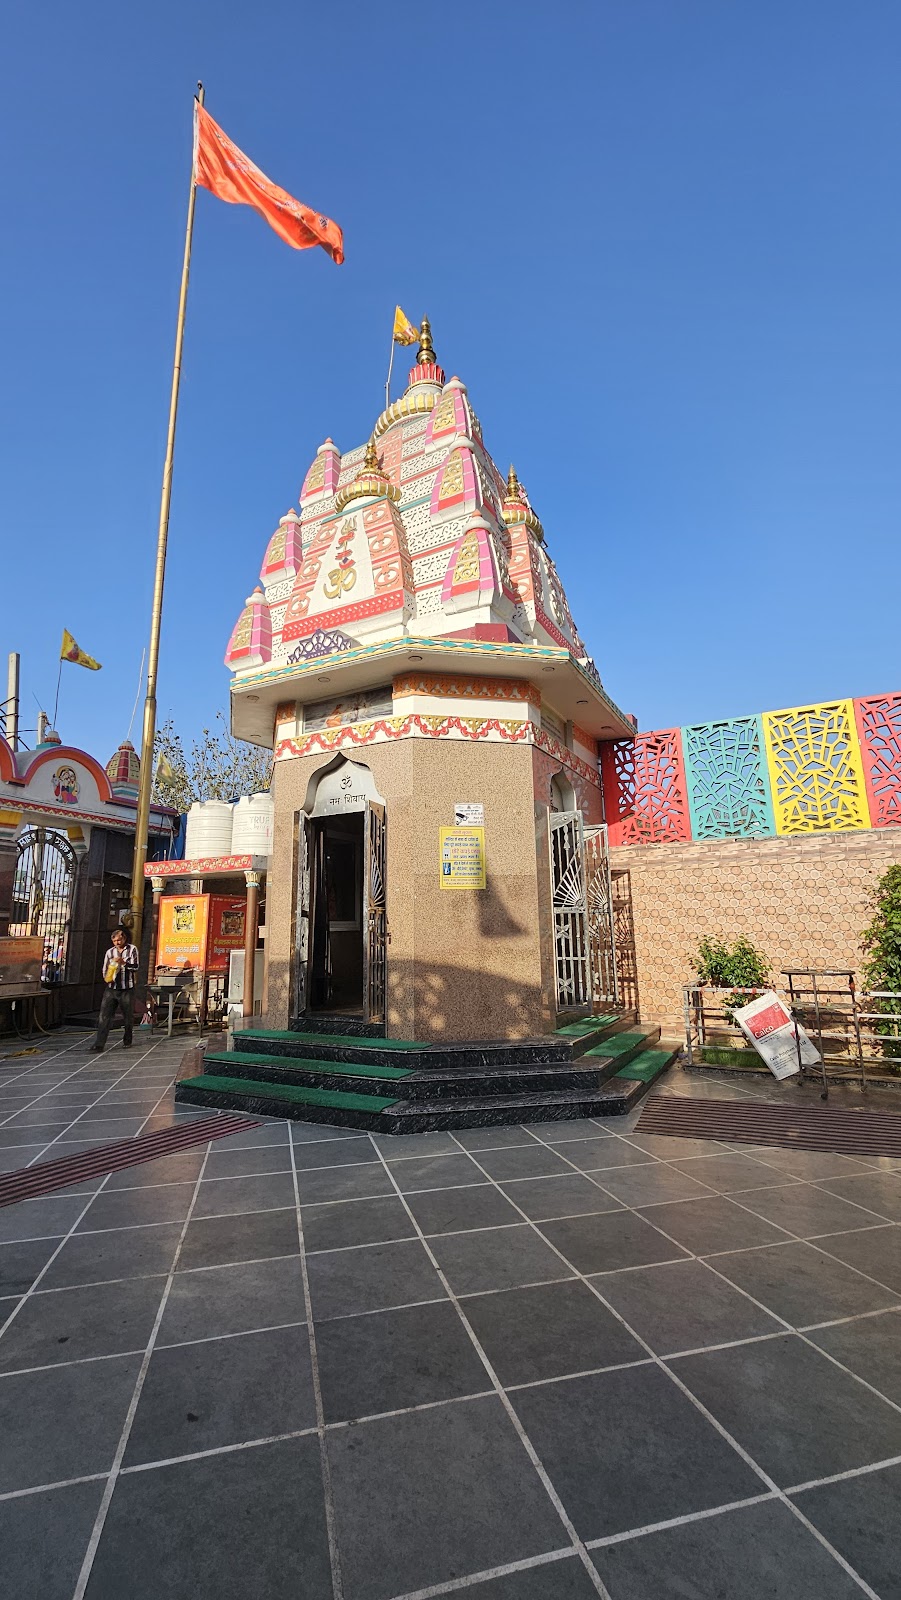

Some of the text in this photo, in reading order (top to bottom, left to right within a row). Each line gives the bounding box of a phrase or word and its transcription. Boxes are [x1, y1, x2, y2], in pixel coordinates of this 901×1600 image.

[340, 775, 352, 789] ॐ
[344, 794, 366, 804] शिवाय
[755, 1025, 774, 1038] Calco
